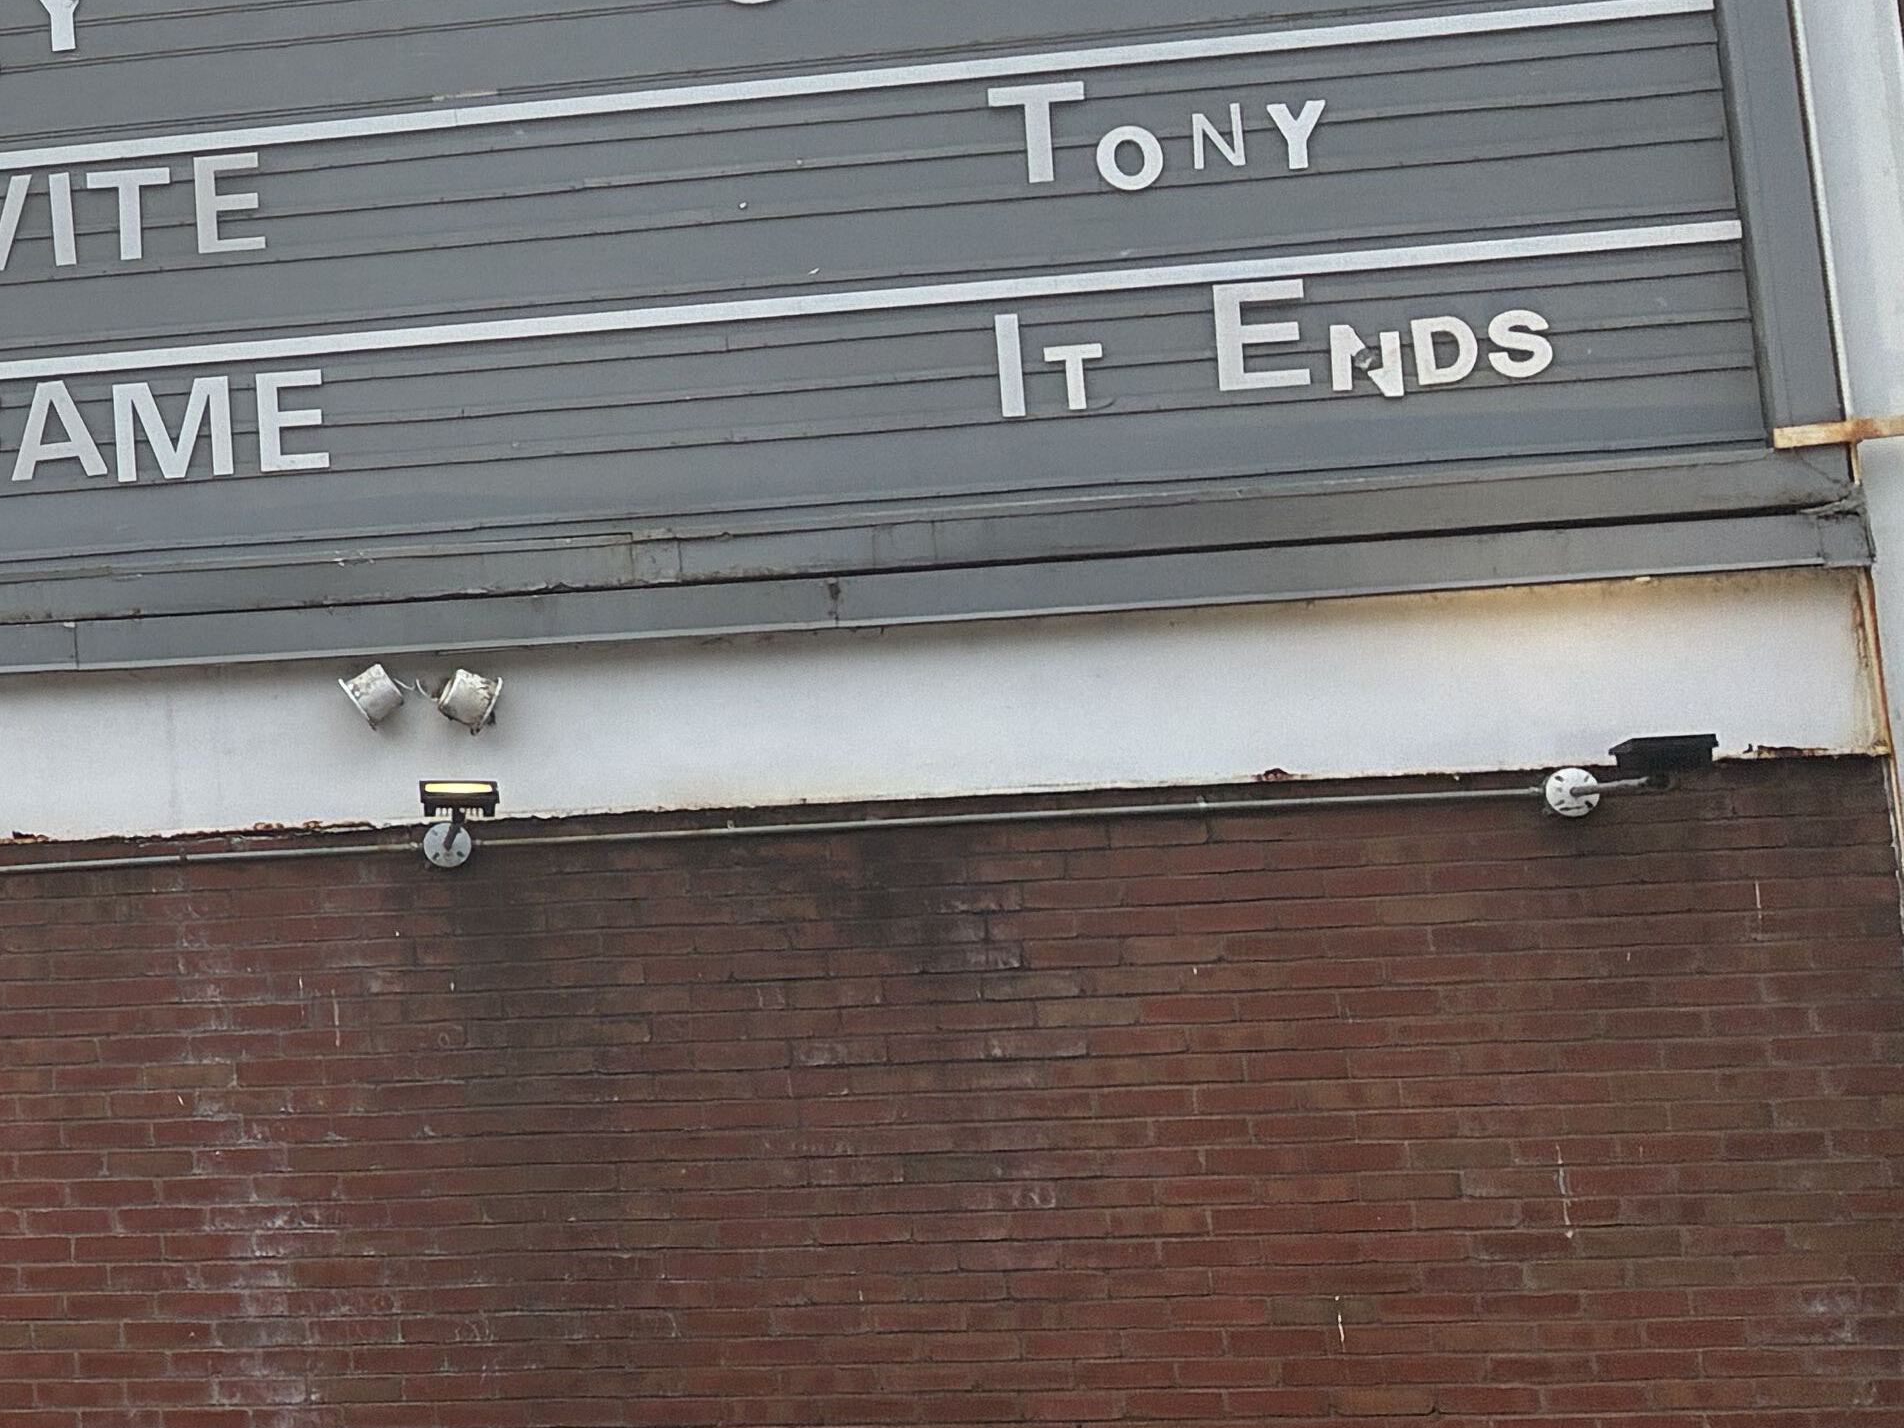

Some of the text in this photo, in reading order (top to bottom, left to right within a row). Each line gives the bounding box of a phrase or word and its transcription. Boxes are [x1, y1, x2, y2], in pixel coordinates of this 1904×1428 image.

[986, 79, 1327, 193] TONY
[993, 277, 1554, 419] IT ENDS
